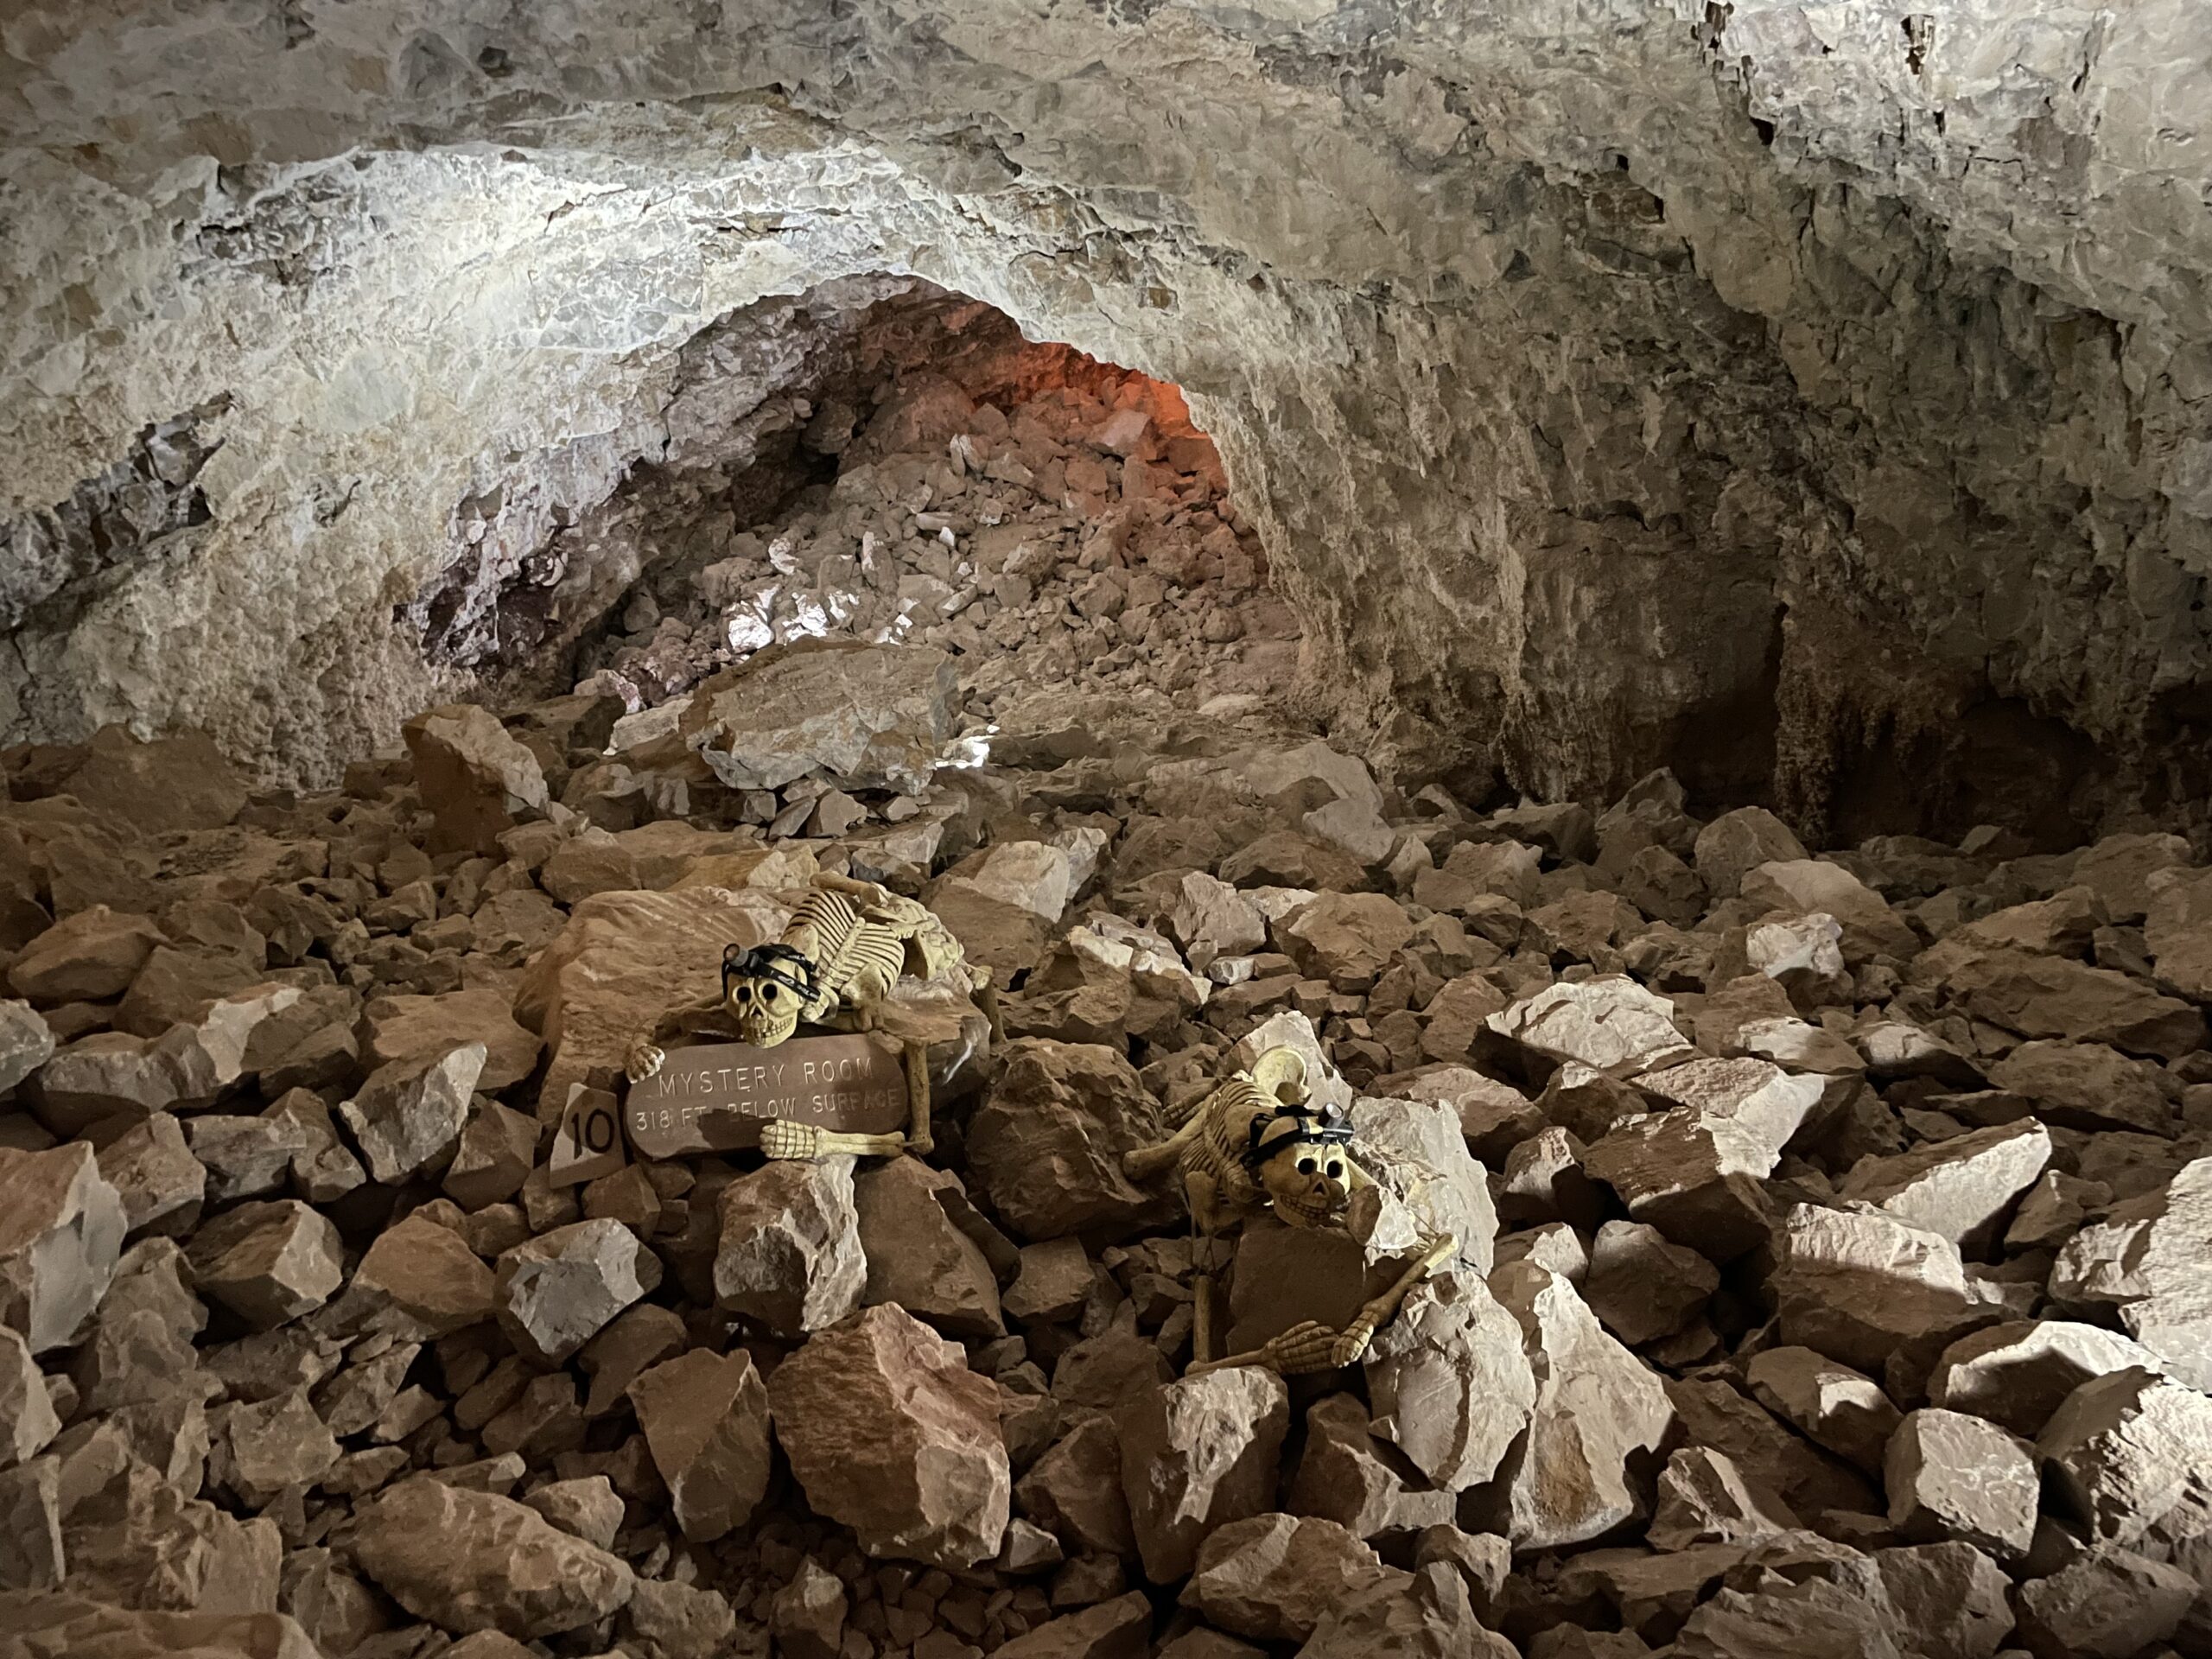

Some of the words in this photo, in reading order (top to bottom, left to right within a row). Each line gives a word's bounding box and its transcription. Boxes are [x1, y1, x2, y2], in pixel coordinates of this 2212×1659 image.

[658, 1064, 785, 1097] MYSTERY
[804, 1057, 874, 1084] ROOM
[636, 1109, 671, 1131] 318
[727, 1097, 796, 1122] BELOW
[812, 1088, 900, 1113] SURFACE
[571, 1109, 615, 1160] 10
